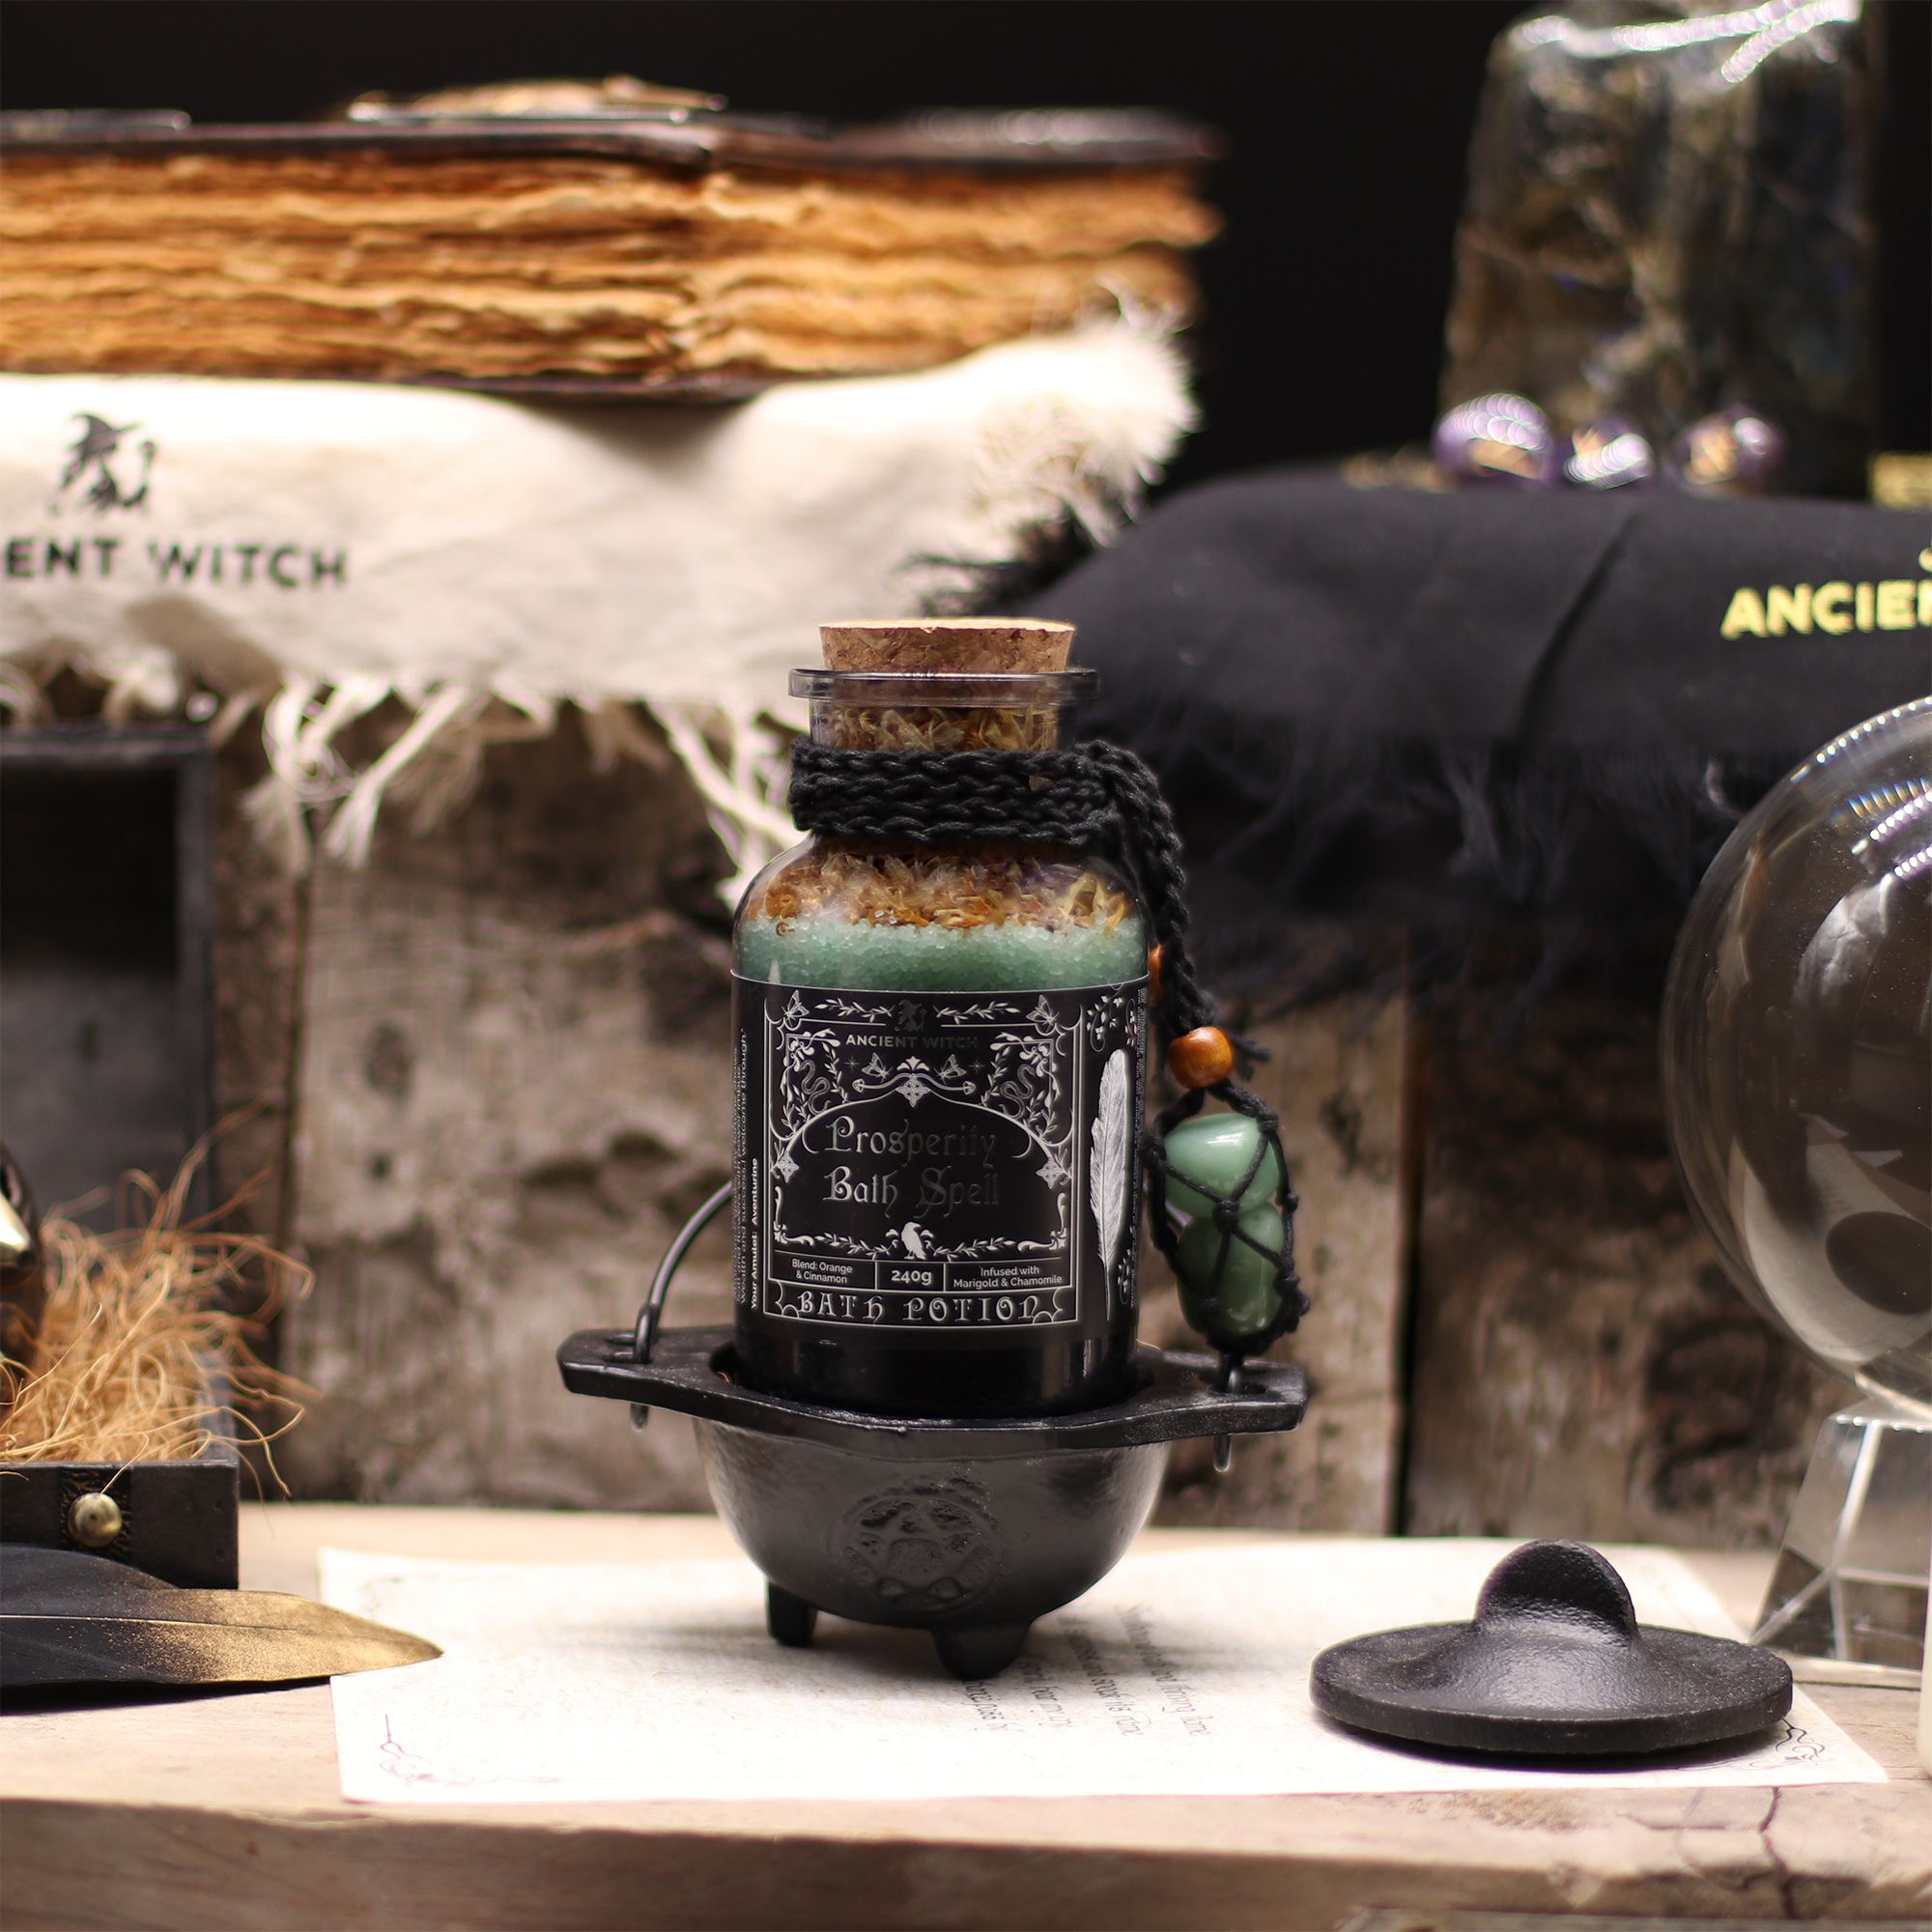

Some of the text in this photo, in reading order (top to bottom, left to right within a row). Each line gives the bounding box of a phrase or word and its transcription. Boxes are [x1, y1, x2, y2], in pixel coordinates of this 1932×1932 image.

[147, 538, 348, 588] WITCH
[845, 1034, 978, 1049] ANCIENT WITCH
[824, 1115, 996, 1168] Prosperity
[822, 1165, 999, 1218] Bath Spell
[792, 1259, 853, 1275] Blend: Orange
[980, 1264, 1040, 1277] Infused with
[796, 1269, 848, 1284] & Cinnamon
[891, 1269, 932, 1286] 240g
[953, 1274, 1063, 1291] Marigold & Chamomile
